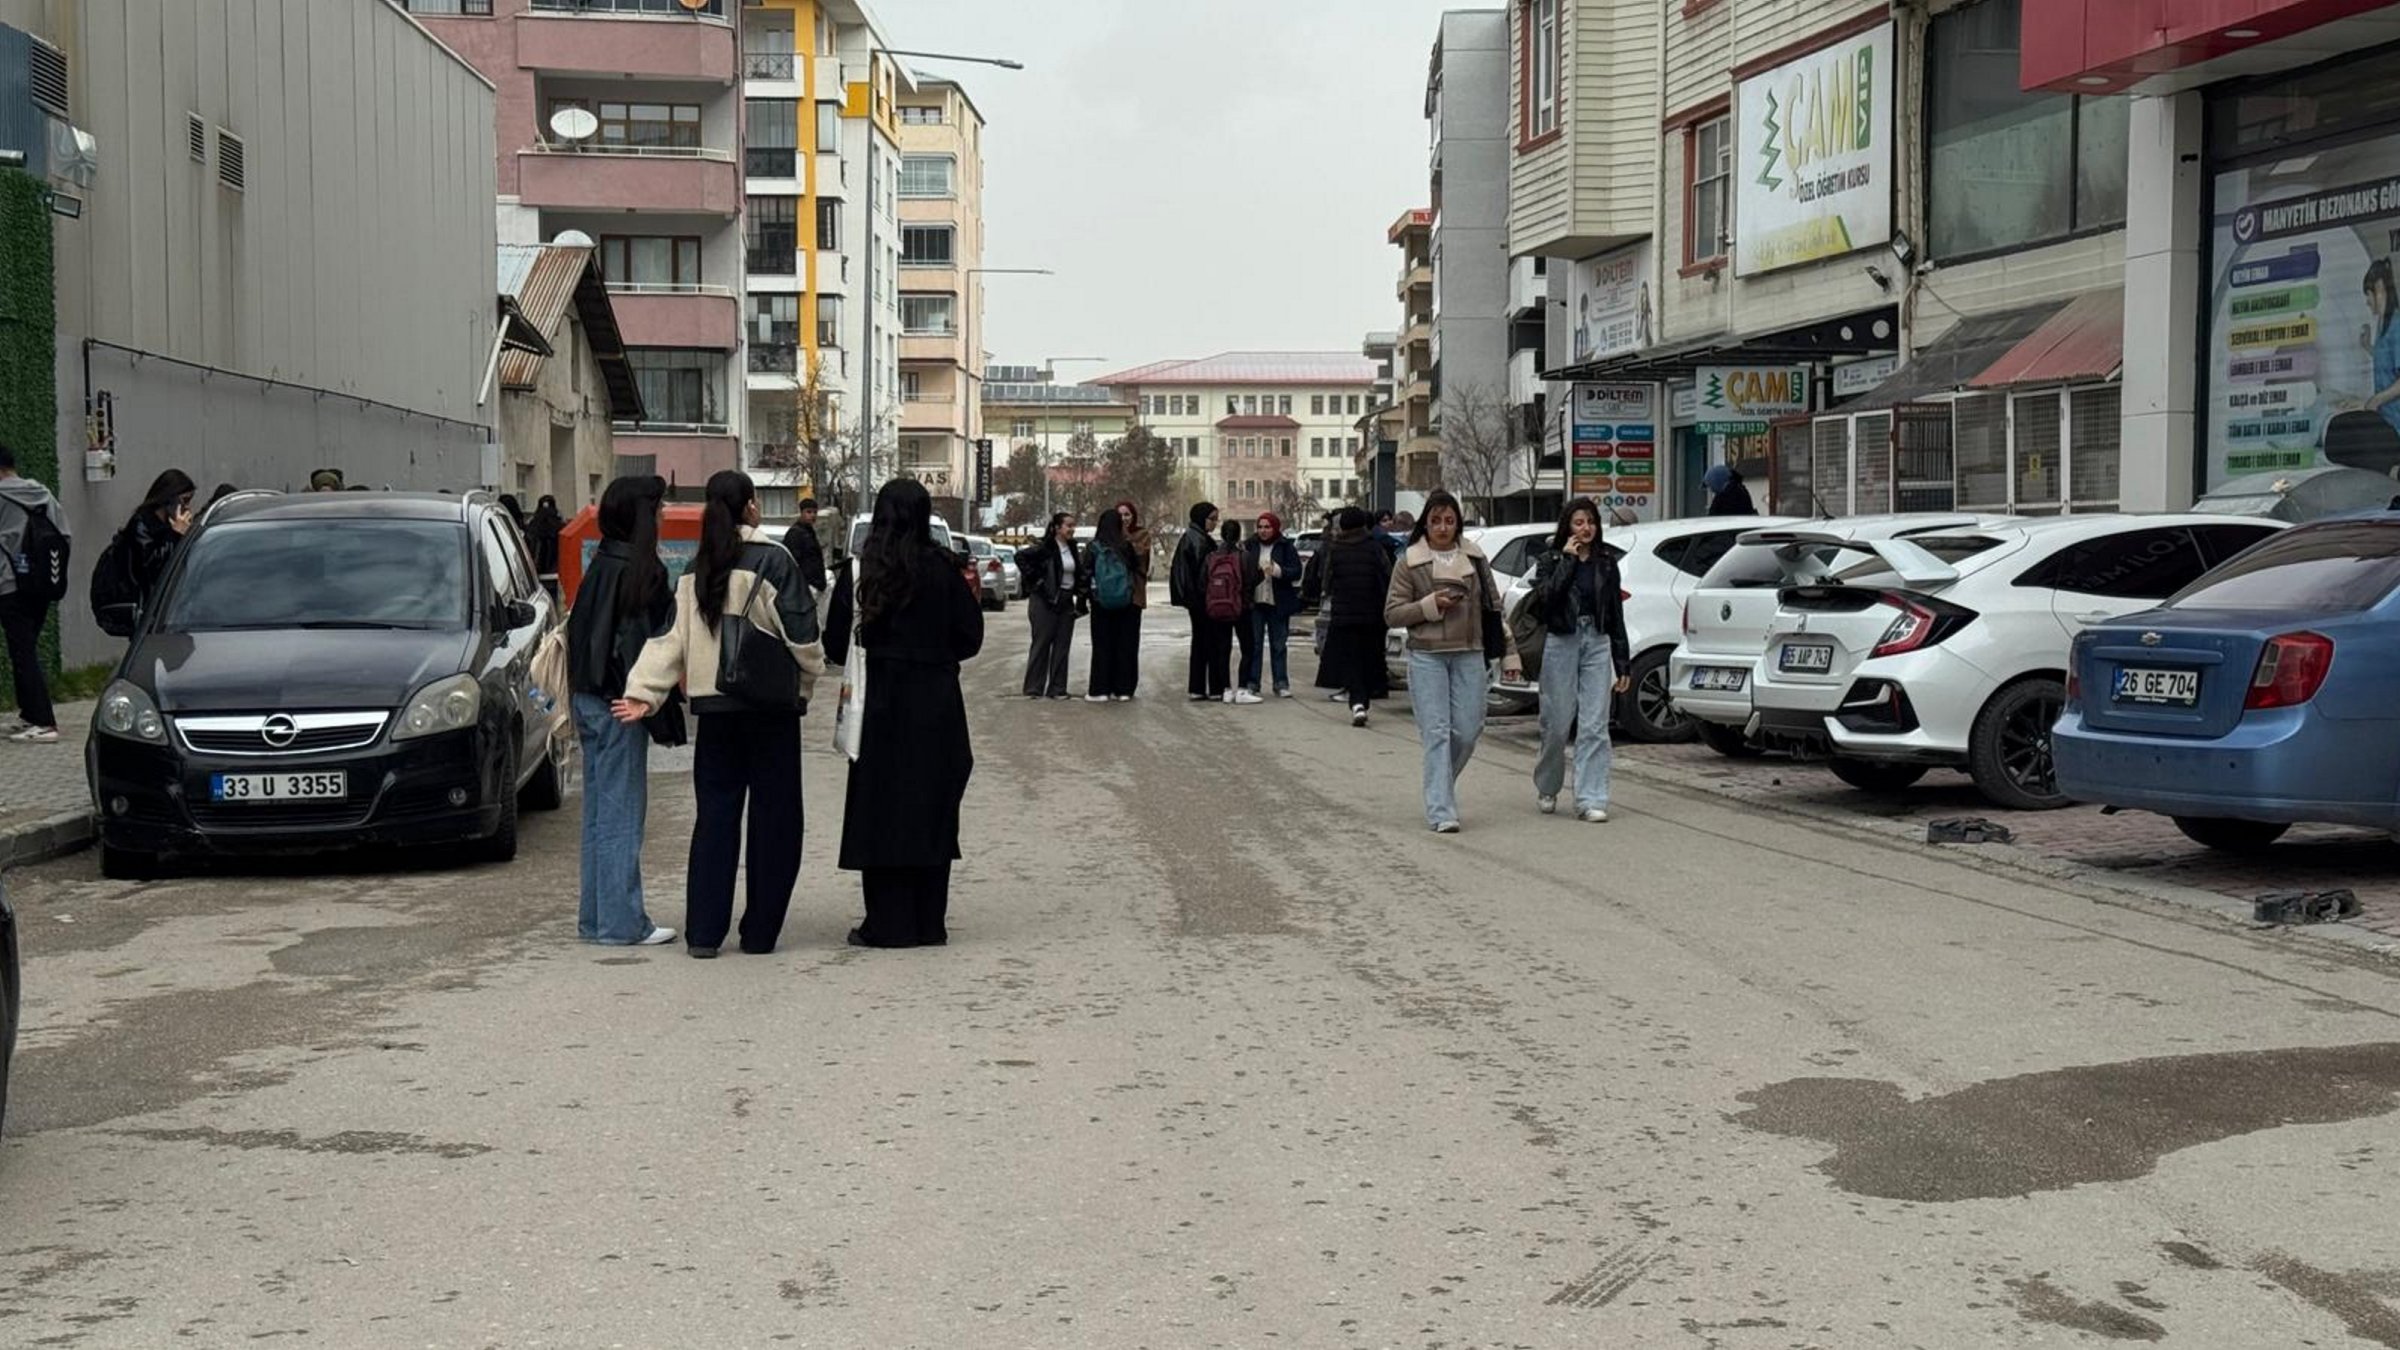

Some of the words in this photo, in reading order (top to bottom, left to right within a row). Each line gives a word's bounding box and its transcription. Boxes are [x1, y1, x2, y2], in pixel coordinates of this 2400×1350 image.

[1784, 53, 1855, 192] ÇAM
[1799, 177, 1815, 203] ÖZEL
[1816, 168, 1846, 199] ÖĞRETİM
[1847, 163, 1870, 190] KURSU
[2262, 198, 2317, 233] MANYETİK
[2319, 188, 2378, 220] REZONANS
[1597, 388, 1643, 403] DİLTEM
[1725, 371, 1790, 409] ÇAM
[2121, 671, 2139, 692] 26
[2144, 672, 2166, 694] GE
[2169, 674, 2195, 697] 704
[224, 777, 250, 798] 33
[262, 776, 275, 796] U
[288, 774, 342, 796] 3355
